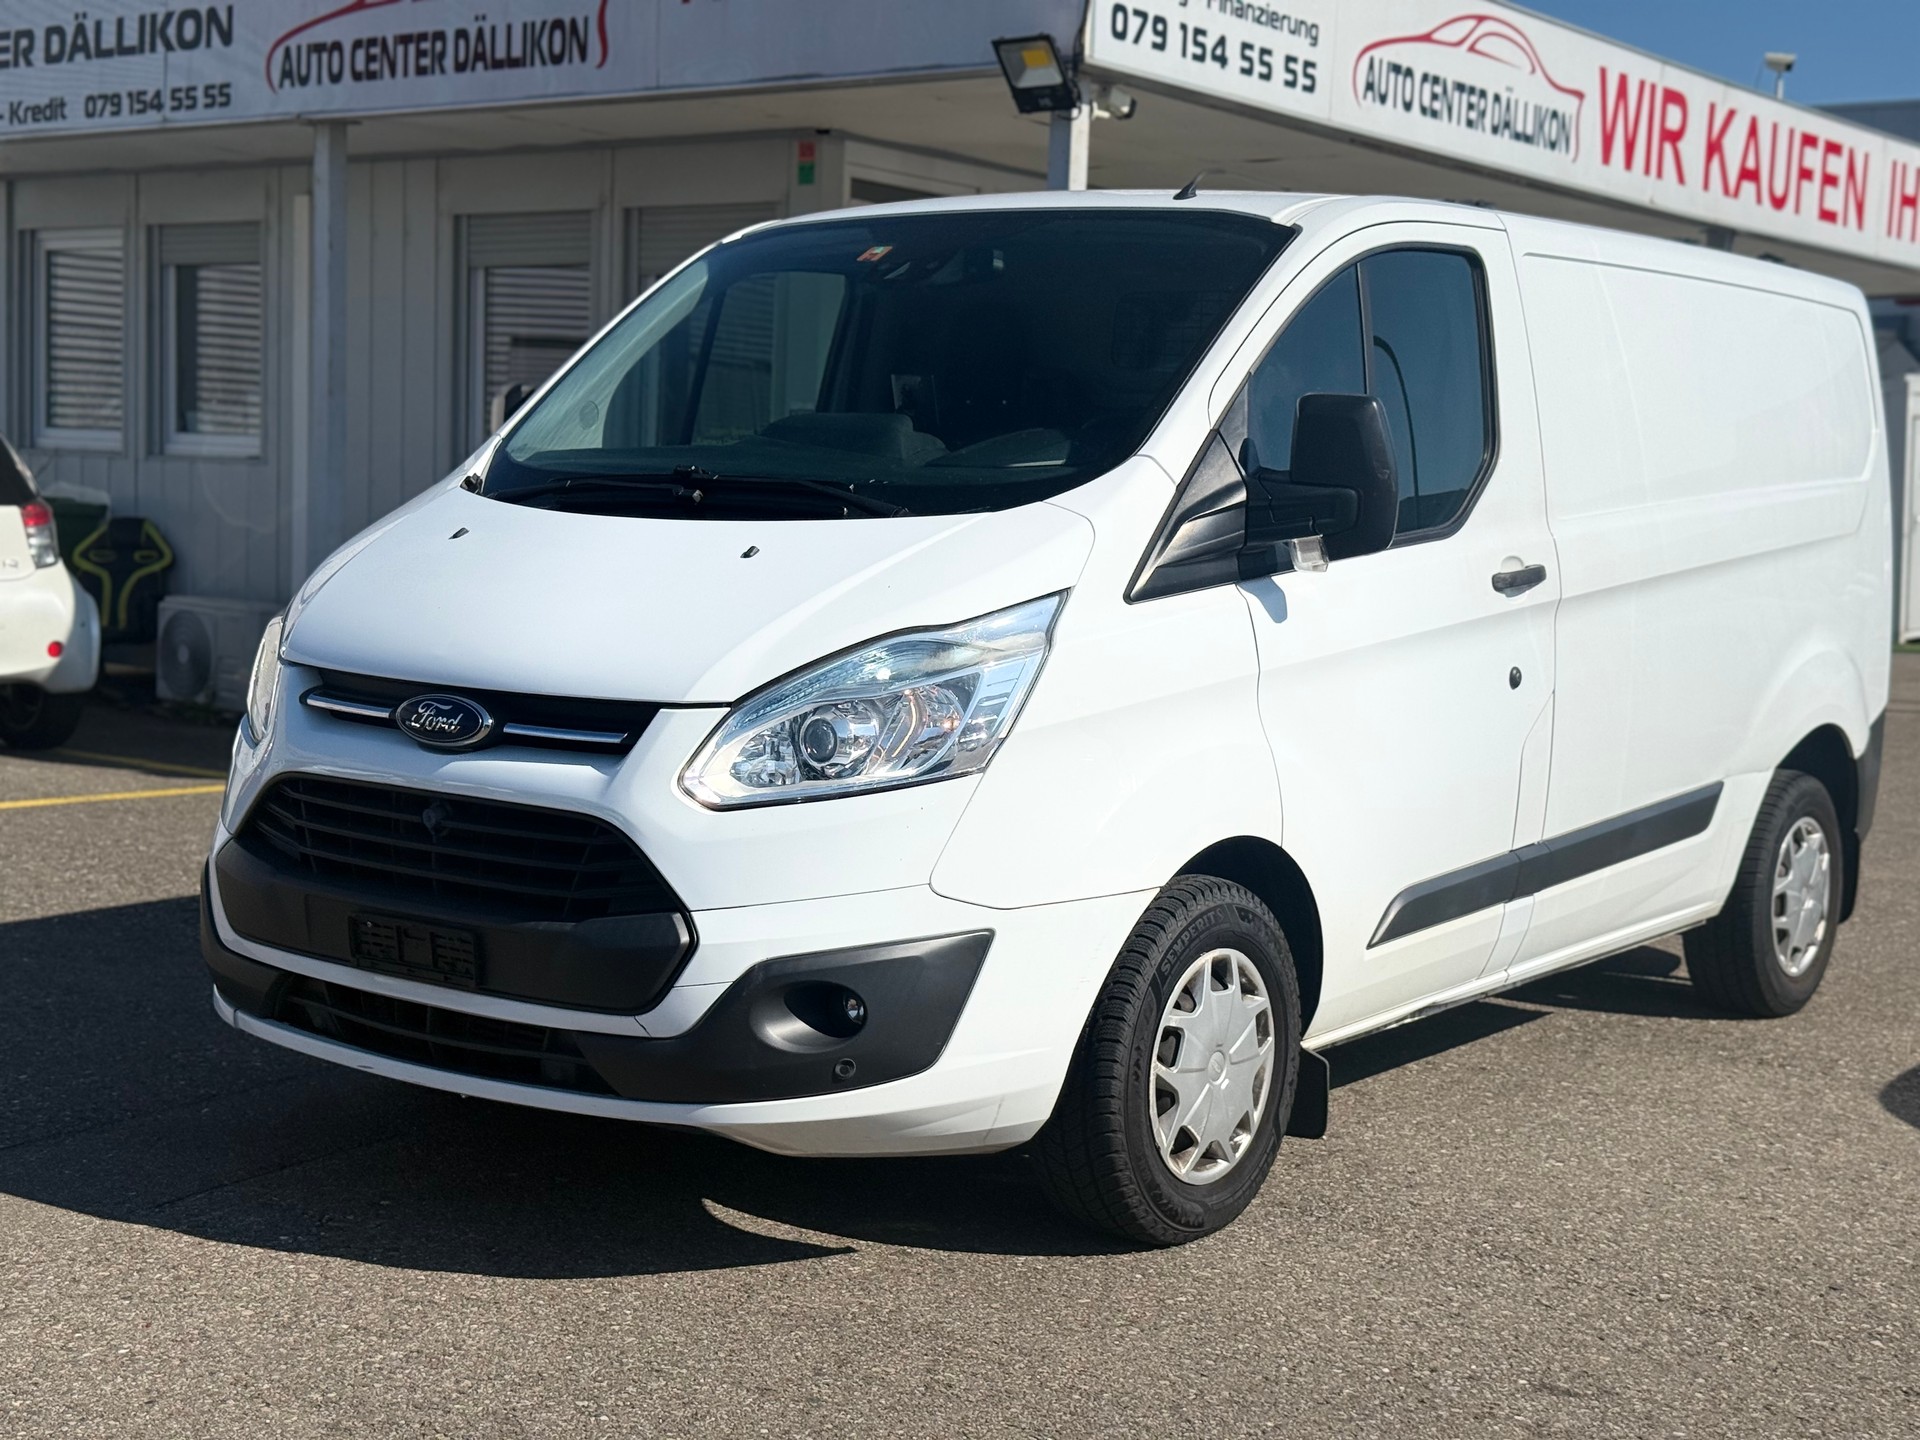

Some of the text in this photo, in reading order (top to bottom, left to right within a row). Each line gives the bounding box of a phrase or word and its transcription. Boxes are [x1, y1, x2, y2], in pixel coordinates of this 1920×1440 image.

[44, 4, 233, 65] DÄLLIKON
[278, 13, 588, 90] AUTO CENTER DÄLLIKON
[1111, 3, 1317, 93] 079 154 55 55
[10, 83, 231, 125] Kredit 079 154 55 55
[1363, 55, 1573, 154] AUTO CENTER DÄLLIKON
[1598, 65, 1688, 187] WIR
[1703, 102, 1869, 231] KAUFEN
[407, 701, 463, 733] Ford
